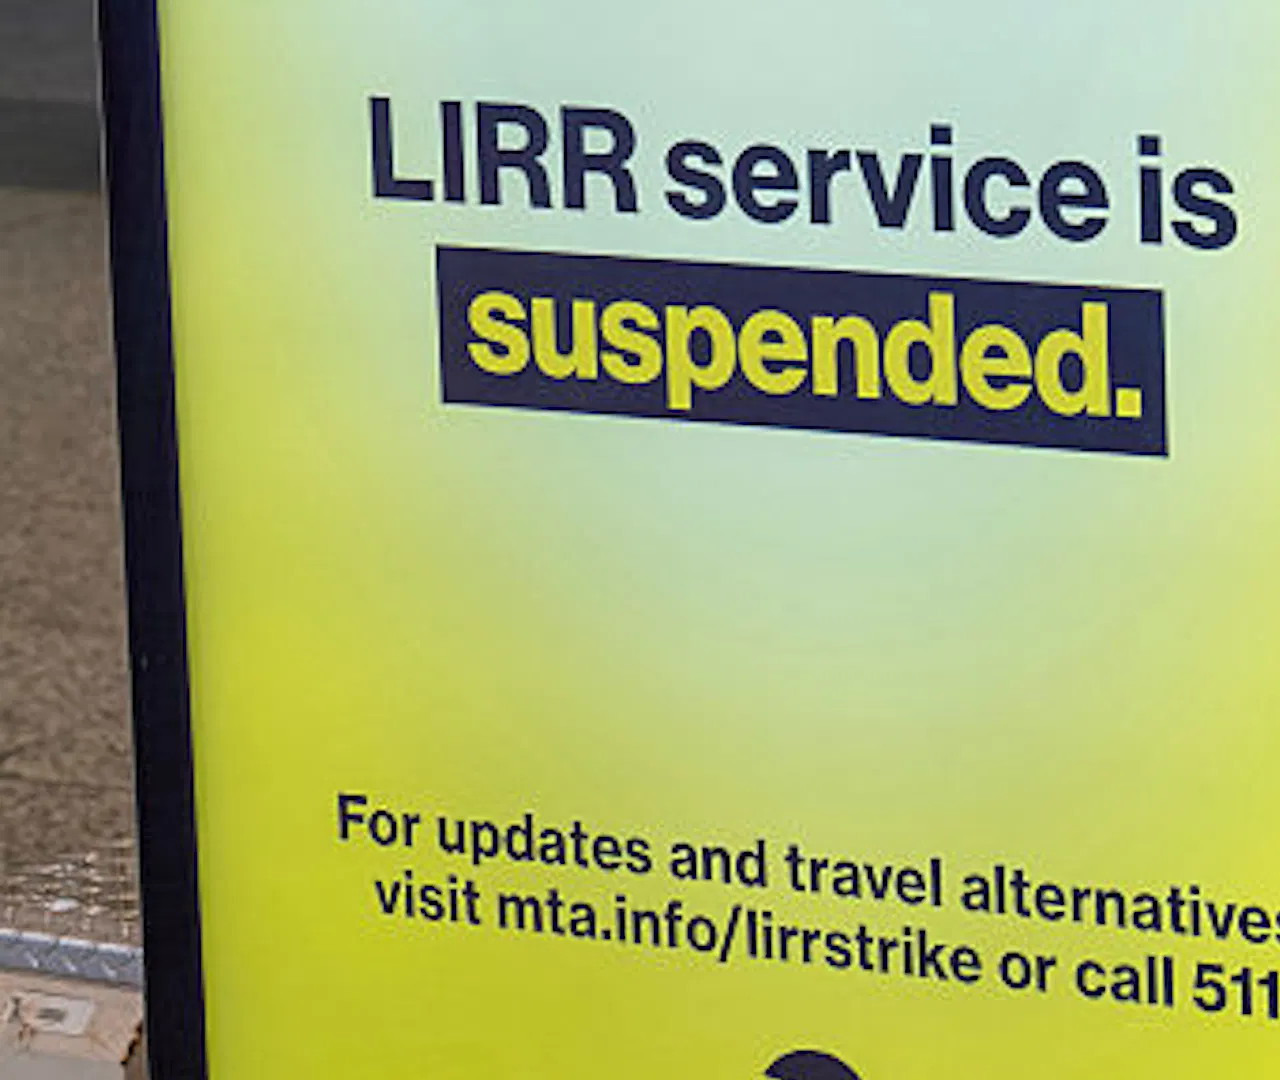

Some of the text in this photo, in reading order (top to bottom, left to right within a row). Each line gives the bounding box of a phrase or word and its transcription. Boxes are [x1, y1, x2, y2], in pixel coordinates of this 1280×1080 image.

[369, 96, 1237, 250] LIRR service is
[467, 285, 1142, 418] suspended.
[337, 794, 421, 848] For
[437, 813, 653, 874] updates
[670, 839, 768, 888] and
[784, 845, 942, 907] travel
[374, 869, 482, 926] visit
[498, 893, 982, 985] mta.info/lirrstrike
[998, 952, 1057, 993] or
[1076, 955, 1174, 1007] call
